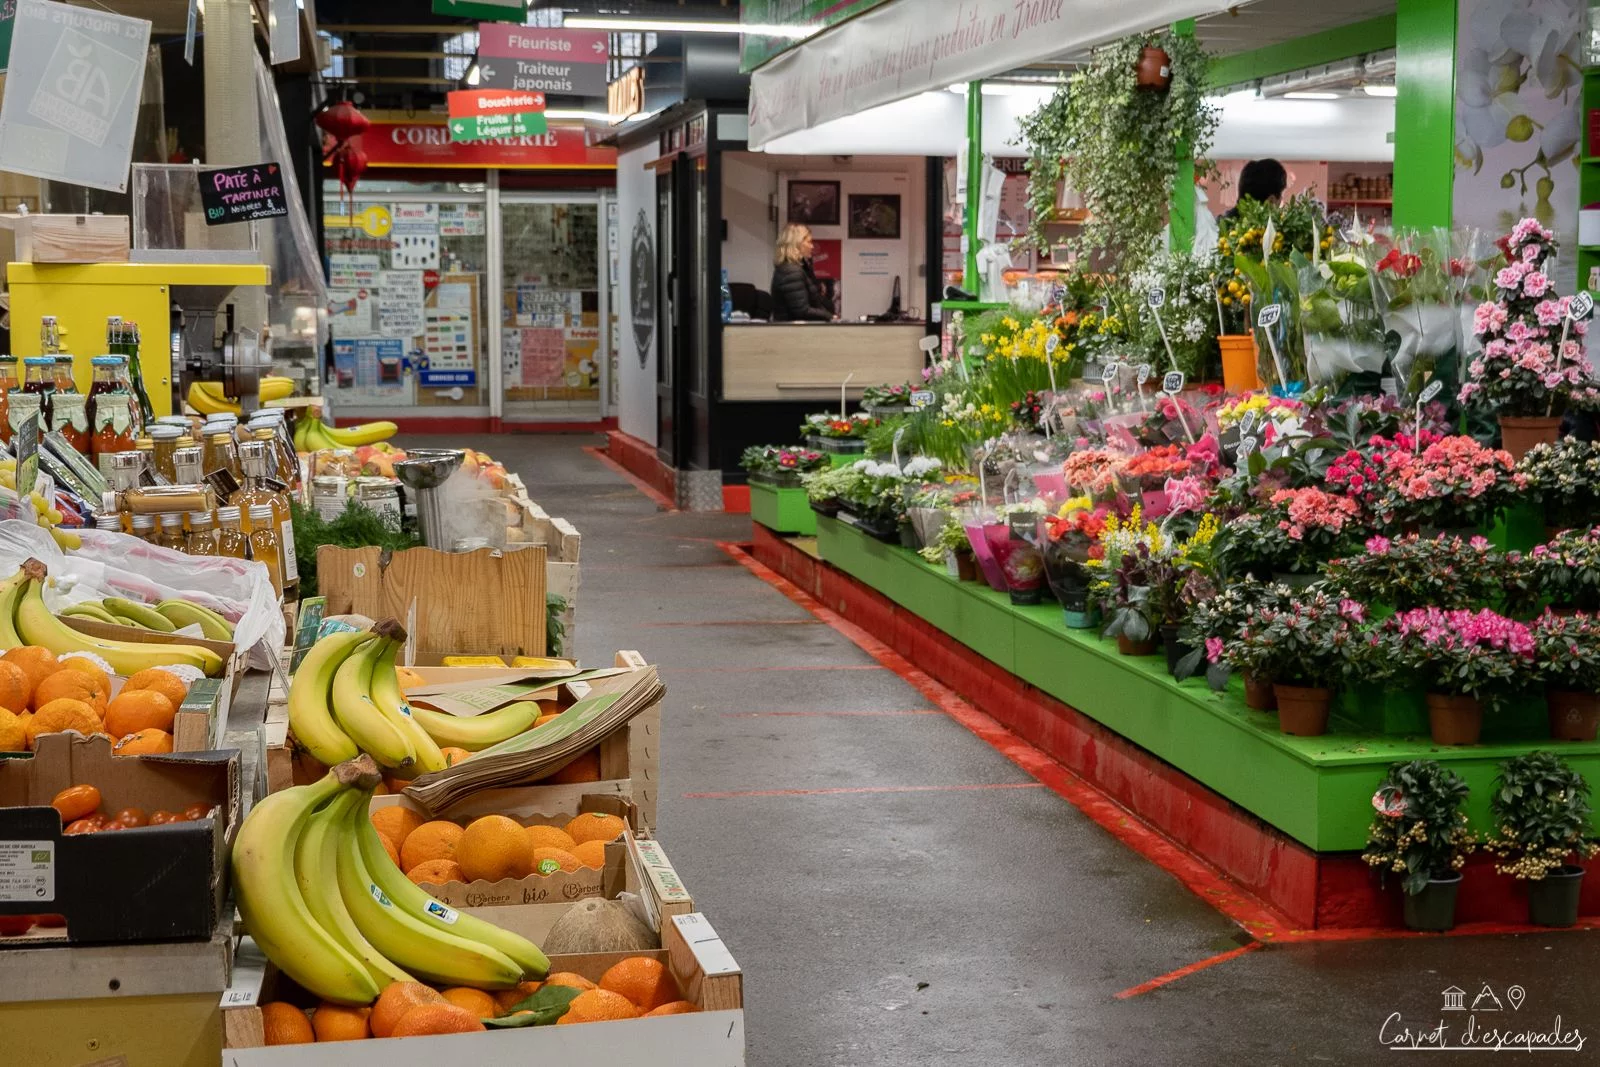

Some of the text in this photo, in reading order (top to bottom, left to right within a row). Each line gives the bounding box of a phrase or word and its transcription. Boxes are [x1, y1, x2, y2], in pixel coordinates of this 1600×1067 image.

[507, 35, 572, 52] Fleuriste
[929, 2, 985, 79] produites
[990, 13, 1006, 41] en
[1012, 0, 1064, 39] France
[517, 61, 571, 77] Traiteur
[513, 76, 572, 91] japonais
[477, 95, 534, 108] Boucherie
[476, 114, 508, 125] Fruits
[222, 187, 280, 204] TARTINER
[208, 207, 225, 219] BIO
[542, 861, 556, 871] bio
[469, 893, 511, 907] Barbera
[523, 887, 551, 904] bio
